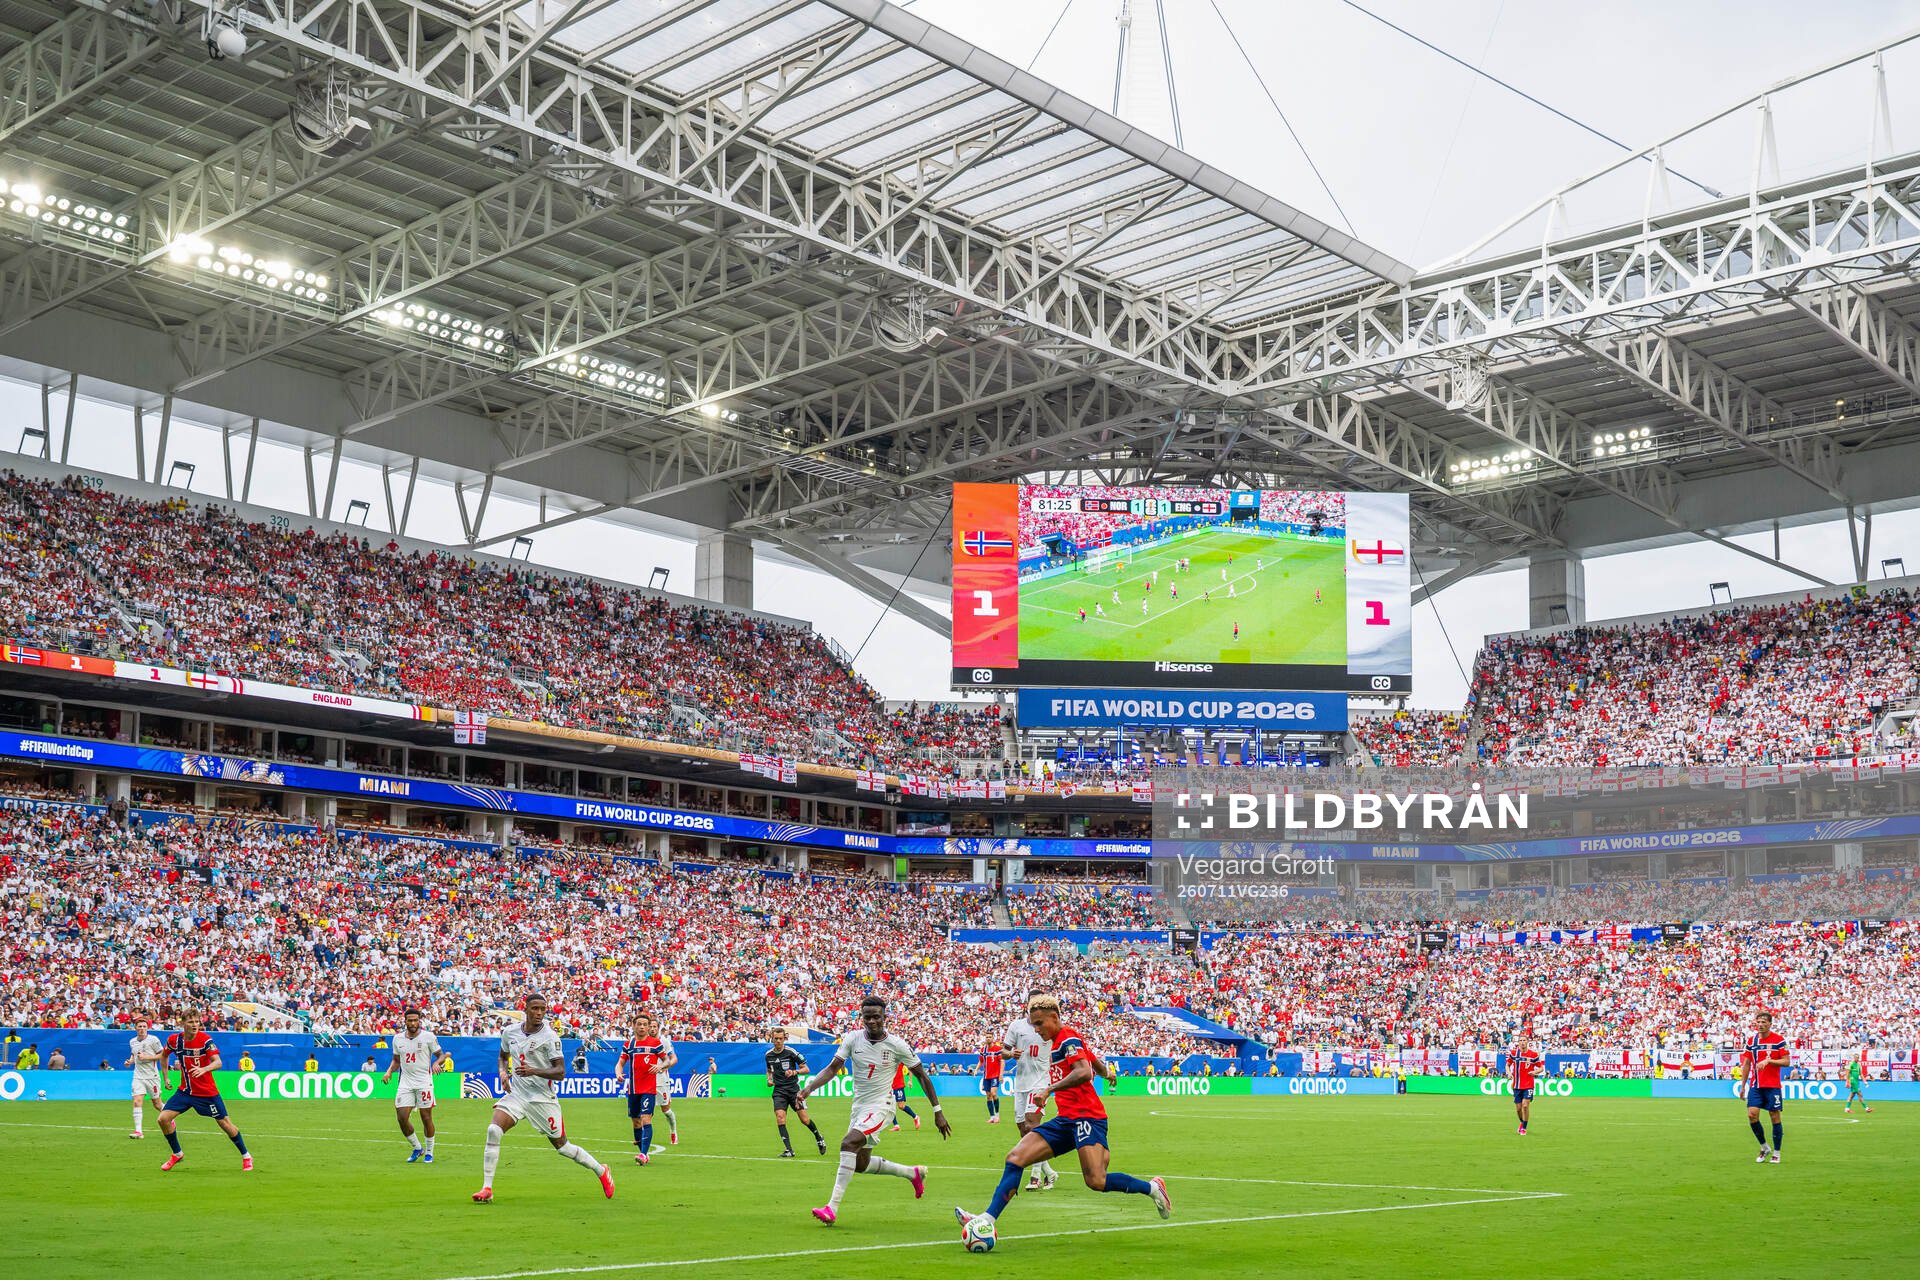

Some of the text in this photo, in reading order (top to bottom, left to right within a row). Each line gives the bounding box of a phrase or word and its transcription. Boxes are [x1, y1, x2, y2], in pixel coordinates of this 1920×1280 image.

[83, 475, 104, 488] 319
[1038, 500, 1072, 510] 81:25
[1110, 500, 1140, 512] NOR 1
[1161, 503, 1192, 513] 1 ENG
[270, 515, 290, 528] 320
[973, 590, 1000, 616] 1
[1366, 601, 1390, 626] 1
[70, 656, 83, 670] 1
[1155, 661, 1213, 672] Hisense
[150, 668, 161, 681] 1
[974, 671, 991, 681] CC
[1373, 678, 1389, 688] CC
[312, 693, 352, 706] ENGLAND
[1051, 699, 1315, 720] FIFA WORLD CUP 2026
[20, 739, 94, 760] #FIFAWorldCup
[360, 777, 410, 796] MIAMI
[576, 802, 714, 830] FIFA WORLD CUP 2026
[844, 834, 879, 849] MIAMI
[1580, 830, 1742, 851] FIFA WORLD CUP 2026
[1096, 843, 1150, 854] #FIFAWorldCup
[1372, 846, 1419, 858] MIAMI
[1029, 1045, 1039, 1057] 10
[405, 1053, 417, 1063] 24
[643, 1055, 650, 1065] 6
[868, 1064, 876, 1080] 7
[238, 1072, 374, 1099] aramco
[602, 1077, 618, 1095] OF
[1147, 1077, 1210, 1095] aramco
[1289, 1077, 1347, 1095] aramco
[421, 1091, 431, 1102] 24
[642, 1098, 649, 1108] 6
[209, 1103, 218, 1114] 5
[547, 1116, 557, 1131] 2
[1075, 1120, 1092, 1137] 20
